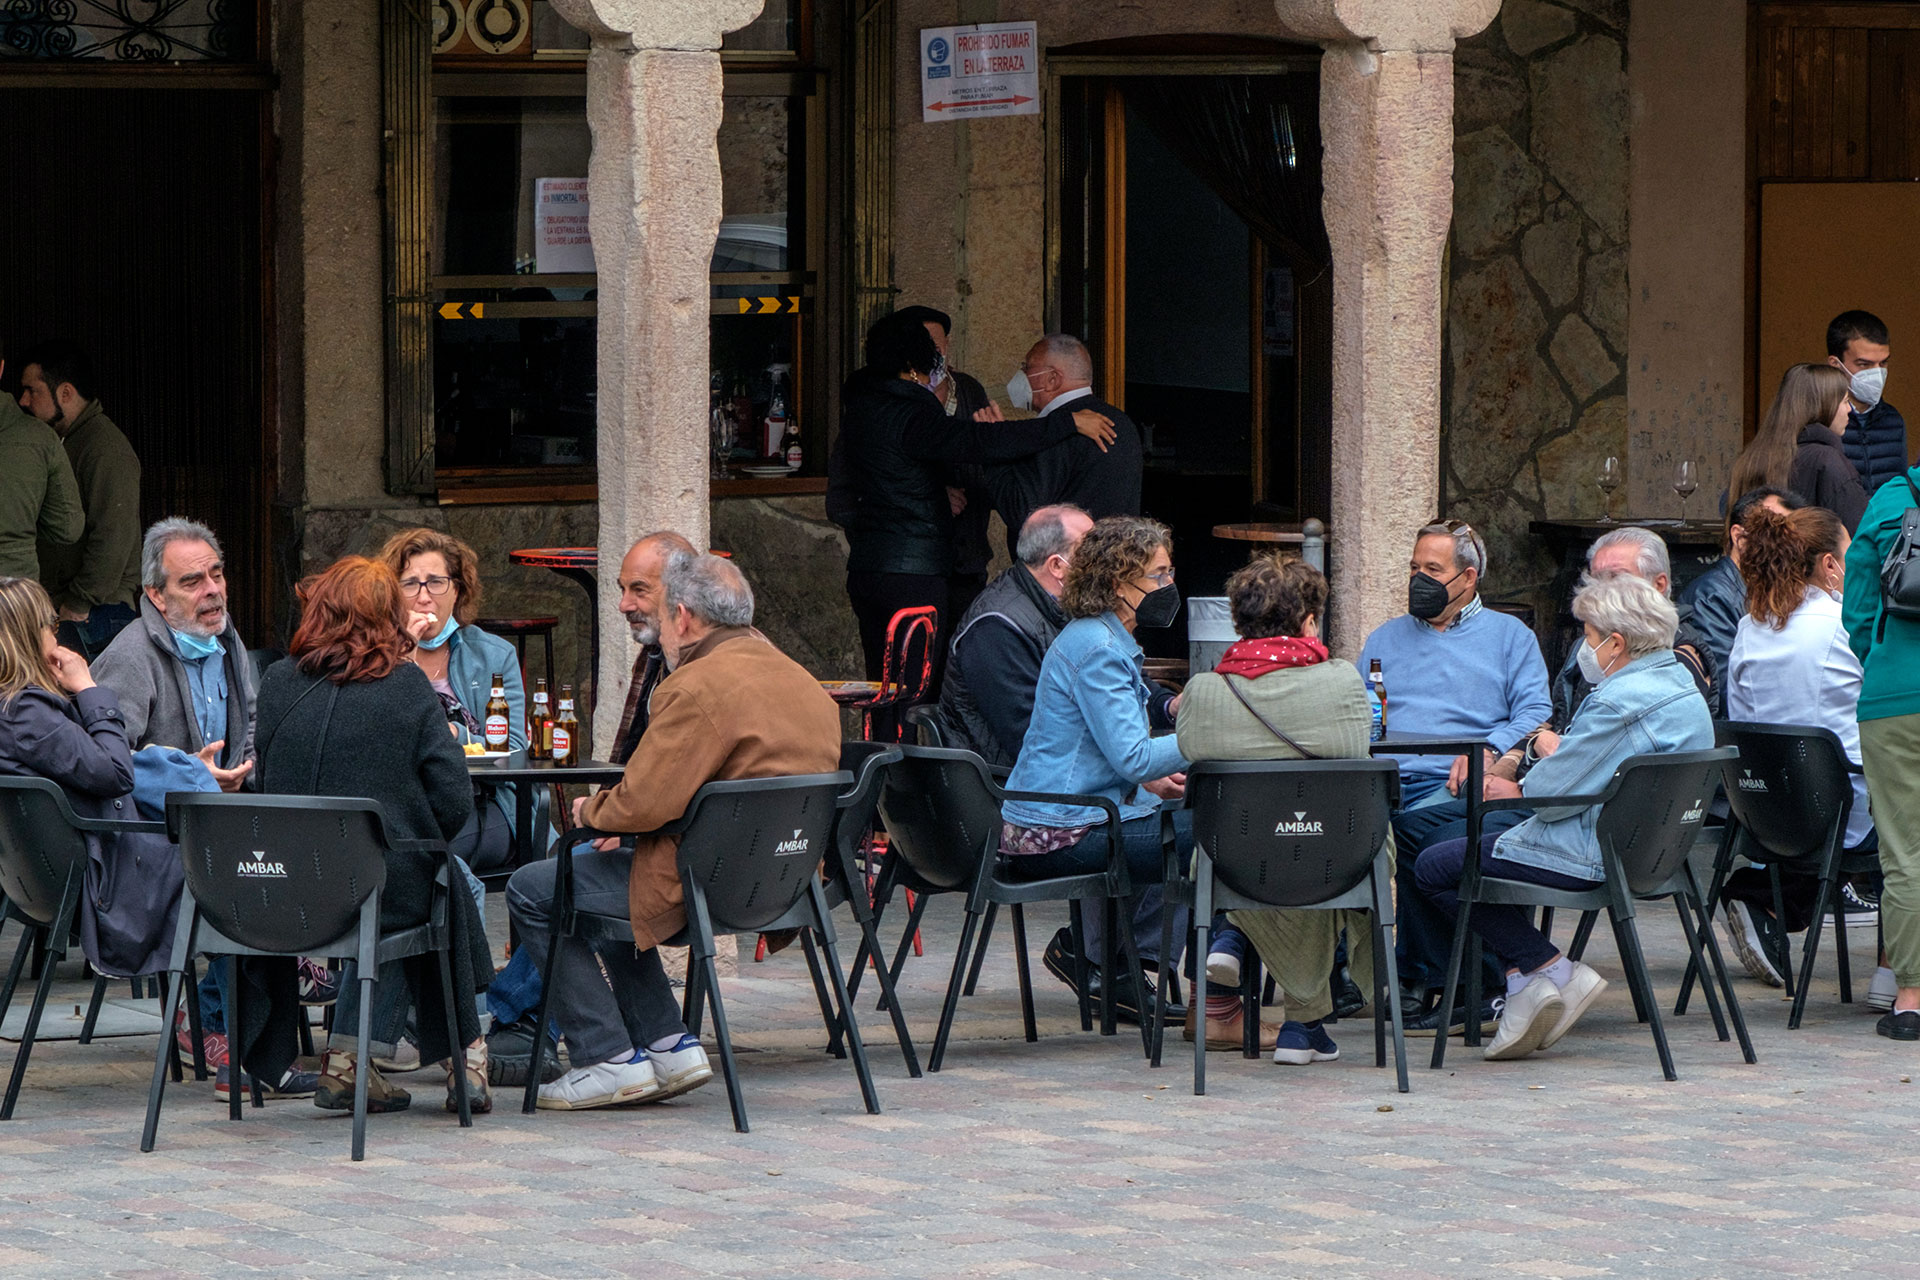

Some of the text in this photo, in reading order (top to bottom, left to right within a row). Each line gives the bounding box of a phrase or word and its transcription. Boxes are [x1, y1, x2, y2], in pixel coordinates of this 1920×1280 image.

[958, 32, 1030, 52] PROHIBIDO FUMAR
[964, 58, 975, 75] EN
[987, 55, 1025, 72] TERRAZA
[1738, 778, 1768, 789] AMBAR
[1275, 821, 1324, 833] AMBAR
[775, 839, 809, 853] AMBAR
[237, 861, 287, 875] AMBAR
